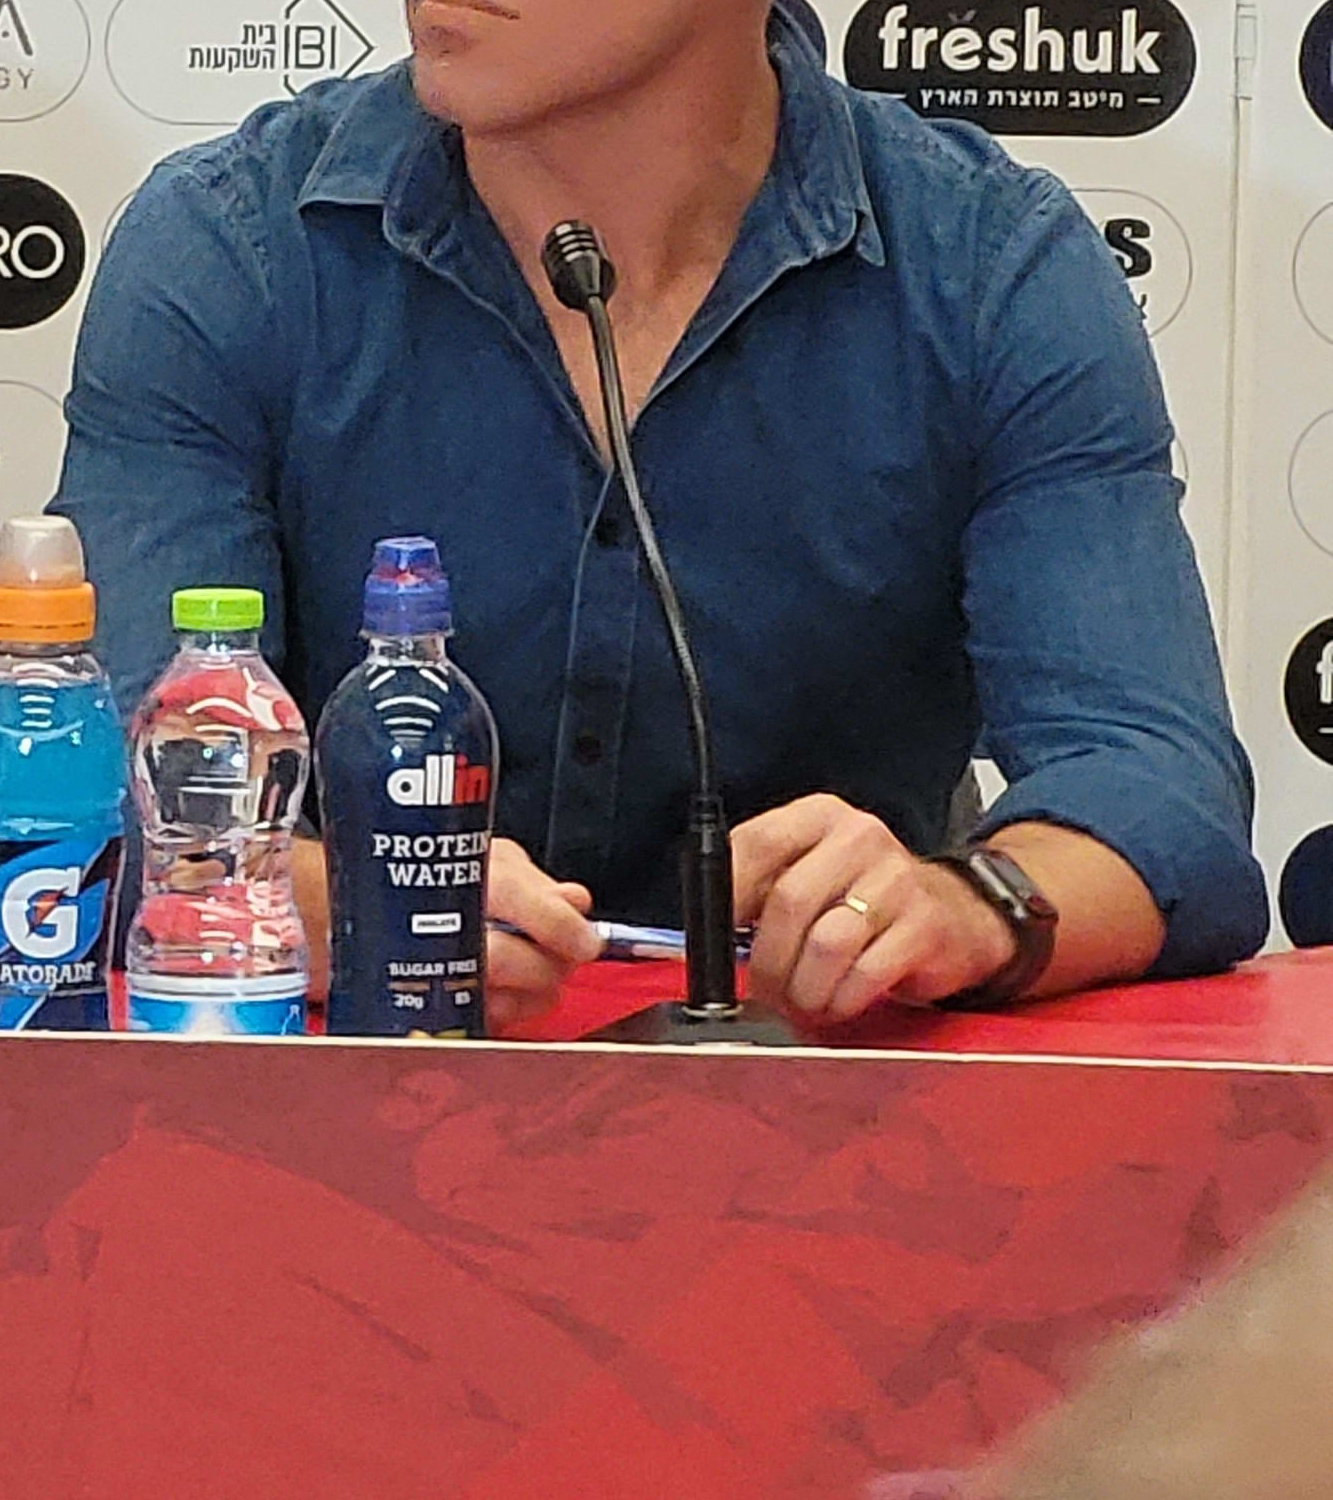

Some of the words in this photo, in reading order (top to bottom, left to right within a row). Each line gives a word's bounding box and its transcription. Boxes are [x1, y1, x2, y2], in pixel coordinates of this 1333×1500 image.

[242, 25, 276, 44] בית
[879, 5, 1160, 73] freshuk
[189, 48, 275, 73] השקעות
[921, 89, 977, 108] הארץ
[988, 90, 1058, 106] תוצרת
[1069, 91, 1123, 108] מיטב
[386, 754, 489, 806] allin
[387, 861, 481, 886] WATER
